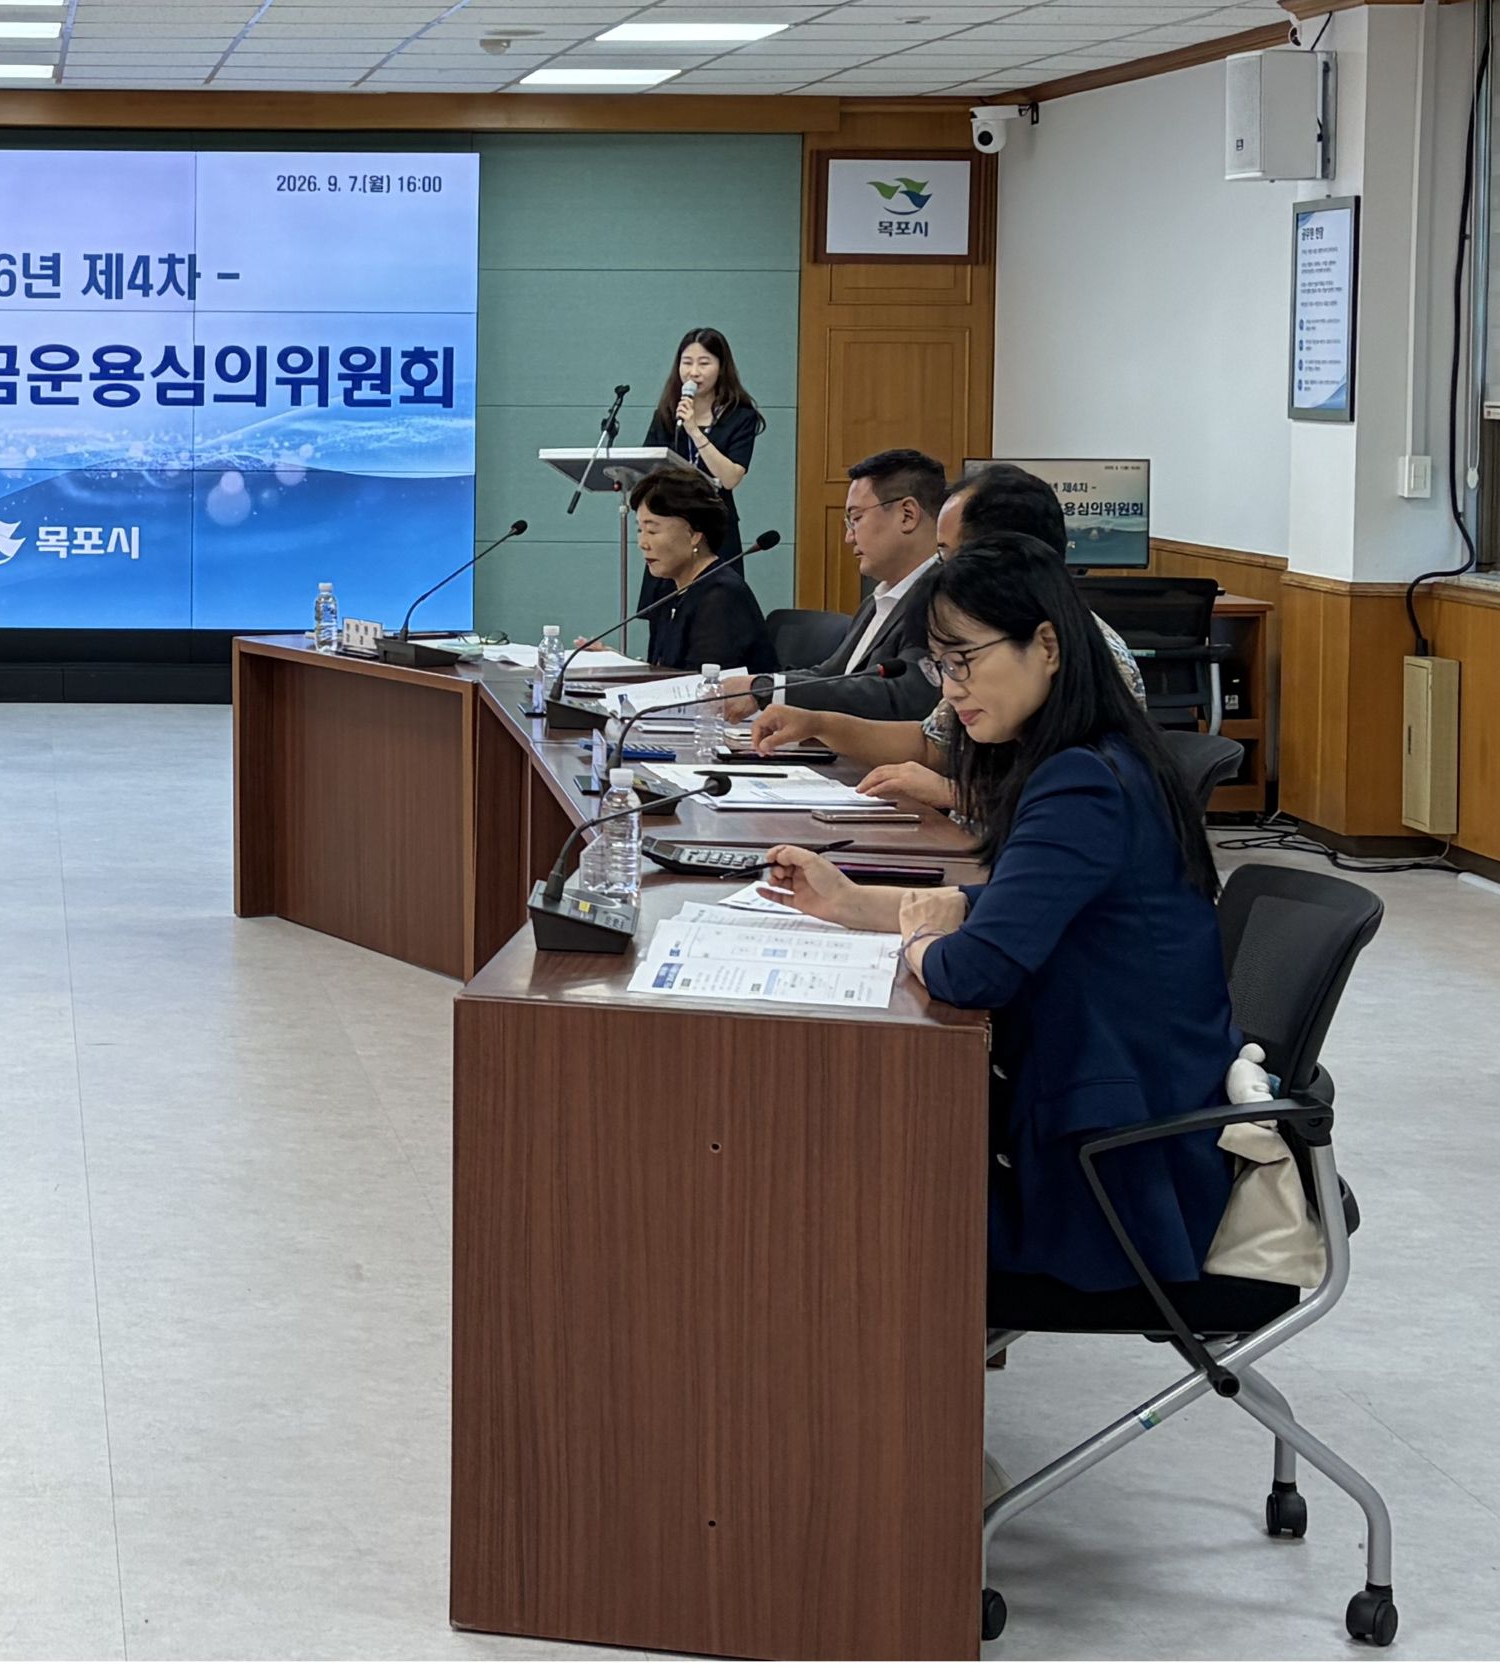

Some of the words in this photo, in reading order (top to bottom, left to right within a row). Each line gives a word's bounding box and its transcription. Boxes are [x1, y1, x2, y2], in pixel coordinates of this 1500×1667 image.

[276, 175, 321, 192] 2026.
[327, 175, 341, 192] 9.
[397, 175, 442, 193] 16:00
[877, 221, 929, 237] 목포시
[81, 252, 201, 300] 제4차
[1061, 502, 1143, 516] 용심의위원회
[36, 525, 140, 560] 목포시
